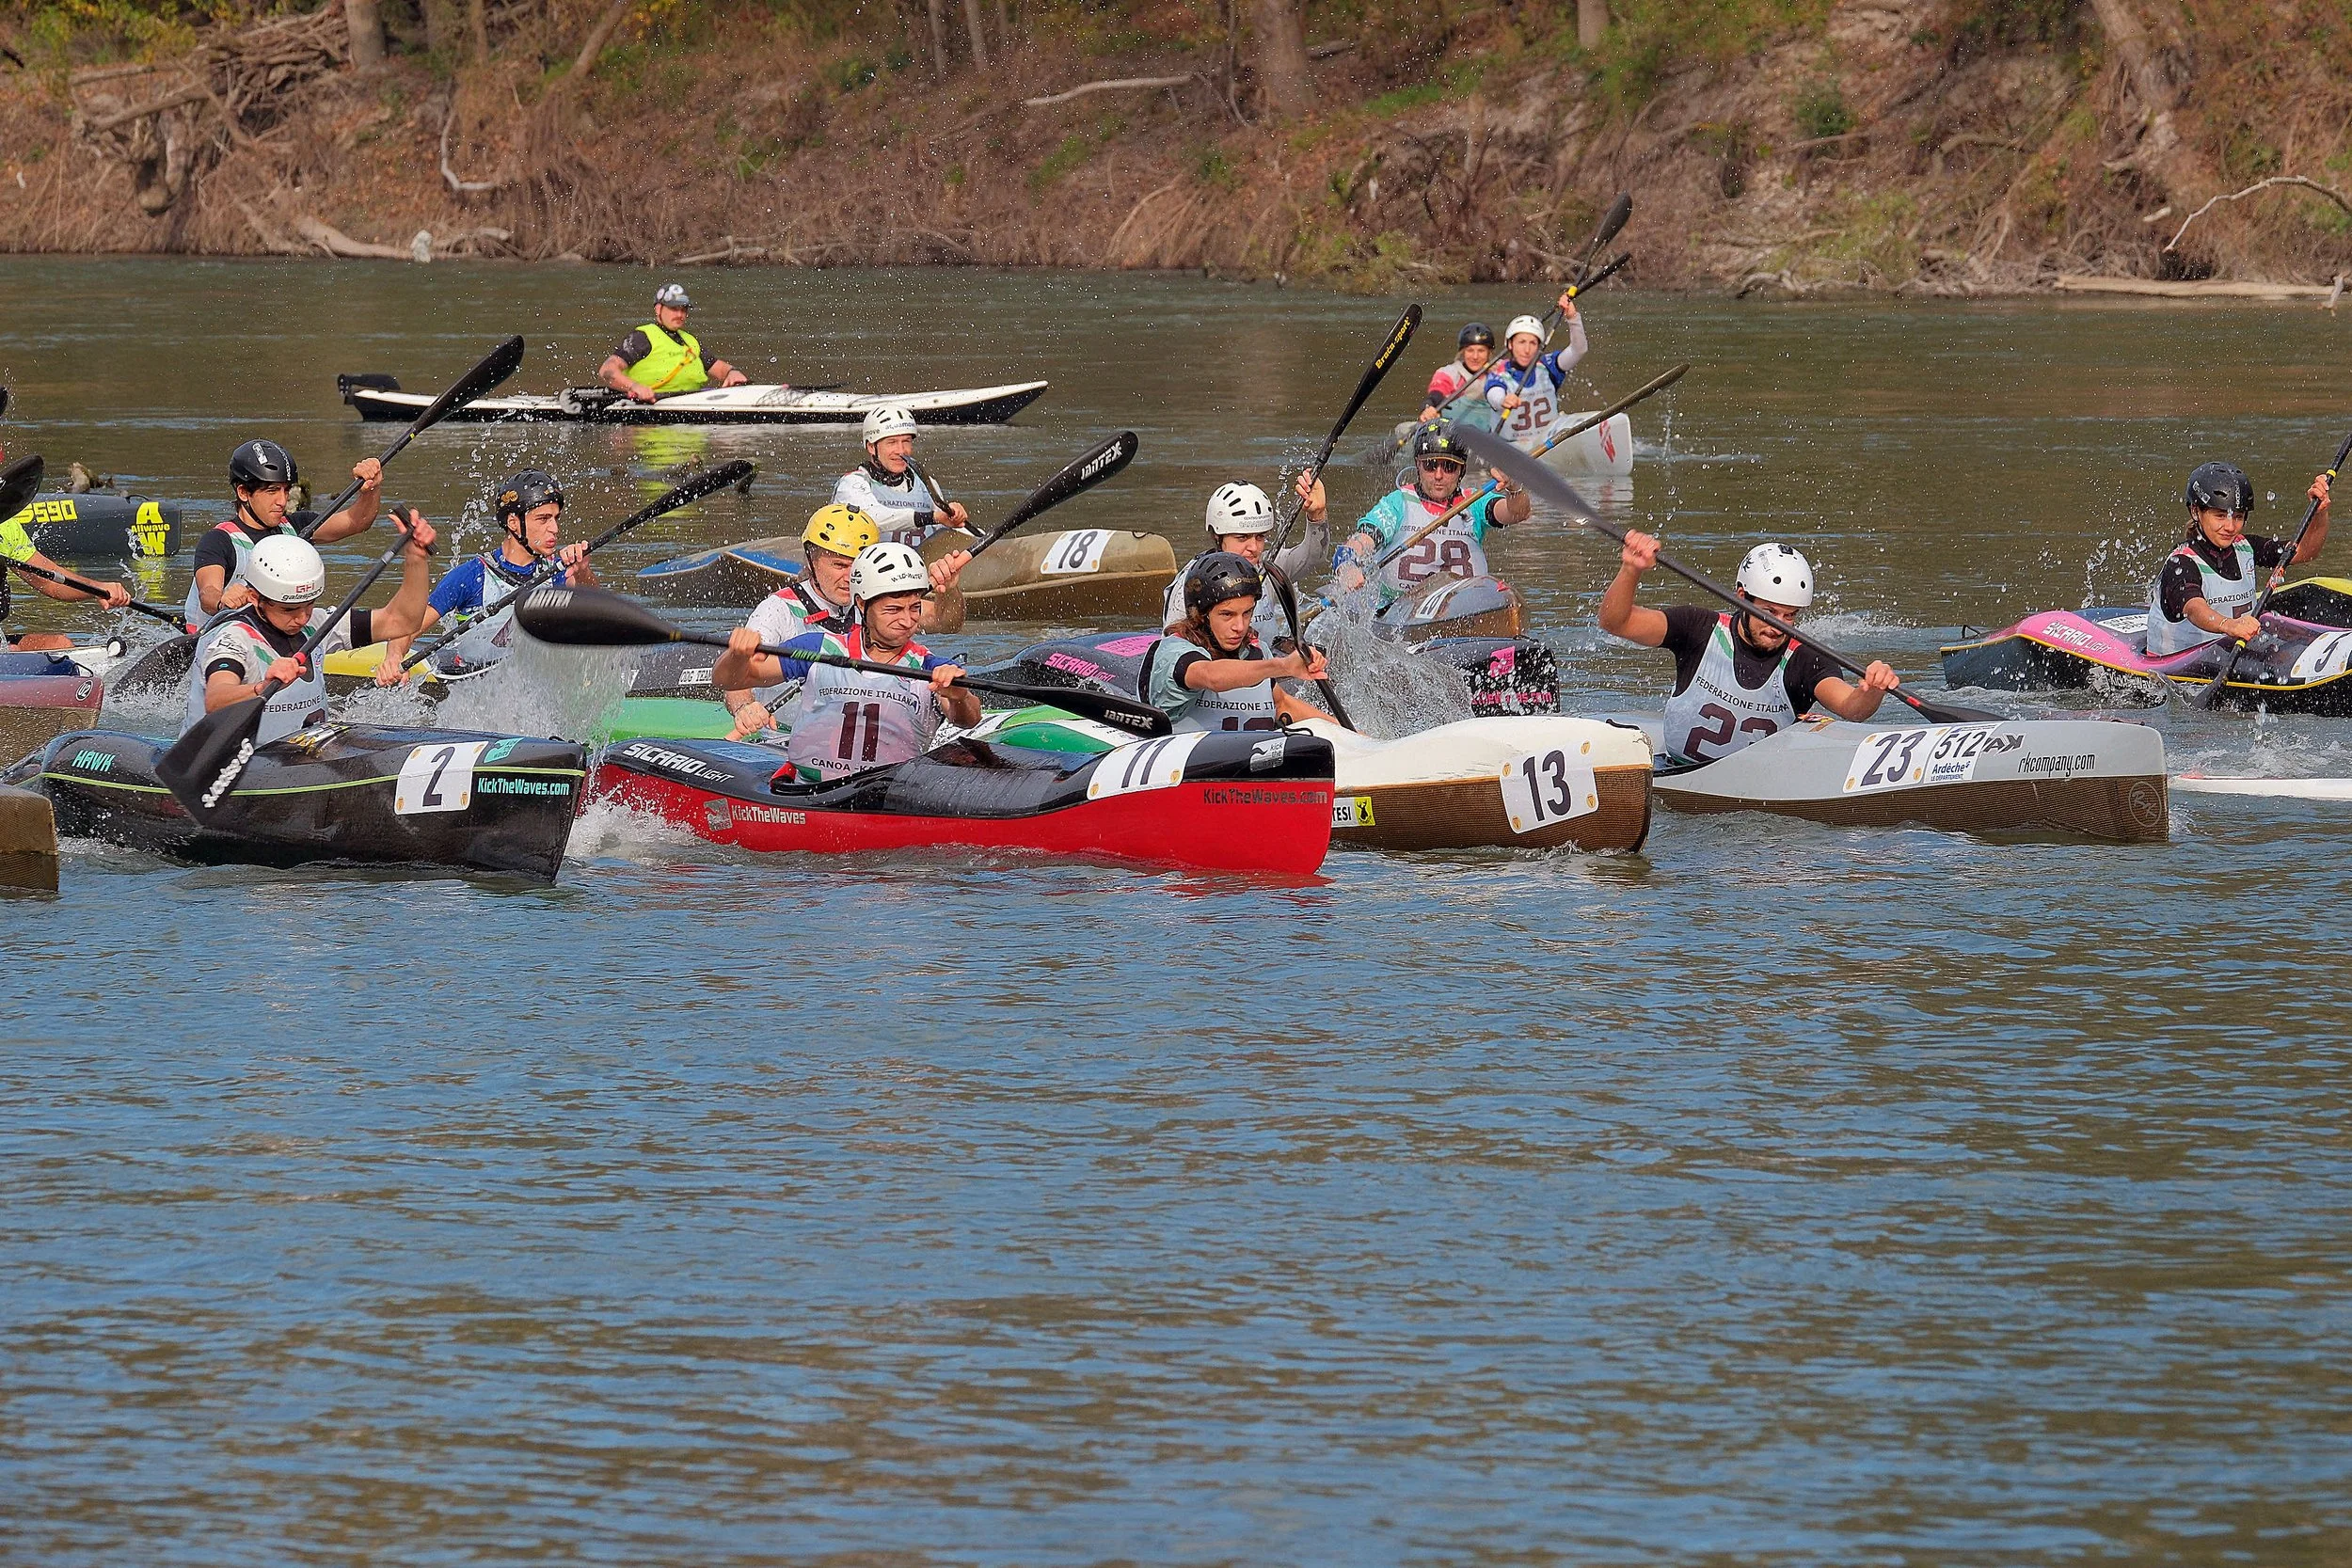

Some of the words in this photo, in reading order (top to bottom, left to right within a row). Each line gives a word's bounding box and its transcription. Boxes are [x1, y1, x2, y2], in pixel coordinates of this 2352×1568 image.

[1511, 397, 1551, 431] 32
[1057, 530, 1099, 569] 18
[1397, 538, 1475, 582] 28
[262, 698, 321, 714] FEDERAZIONE
[819, 687, 873, 698] FEDERAZIONE
[875, 689, 918, 712] ITALIANA
[1195, 698, 1262, 711] FEDERAZIONE
[1694, 675, 1754, 711] FEDERAZIONE
[837, 701, 881, 763] 11
[72, 750, 115, 772] HAWK
[622, 742, 707, 773] SICARIO
[694, 767, 735, 783] LIGHT
[811, 757, 851, 772] CANOA
[1120, 736, 1177, 789] 11
[1861, 730, 1928, 786] 23
[1934, 731, 1987, 760] 512
[2017, 752, 2096, 778] rkcompany.com
[421, 746, 456, 807] 2
[477, 777, 570, 796] KickTheWaves.com
[1522, 749, 1572, 822] 13
[1203, 787, 1328, 805] KickTheWaves.com
[731, 805, 806, 825] KickTheWaves
